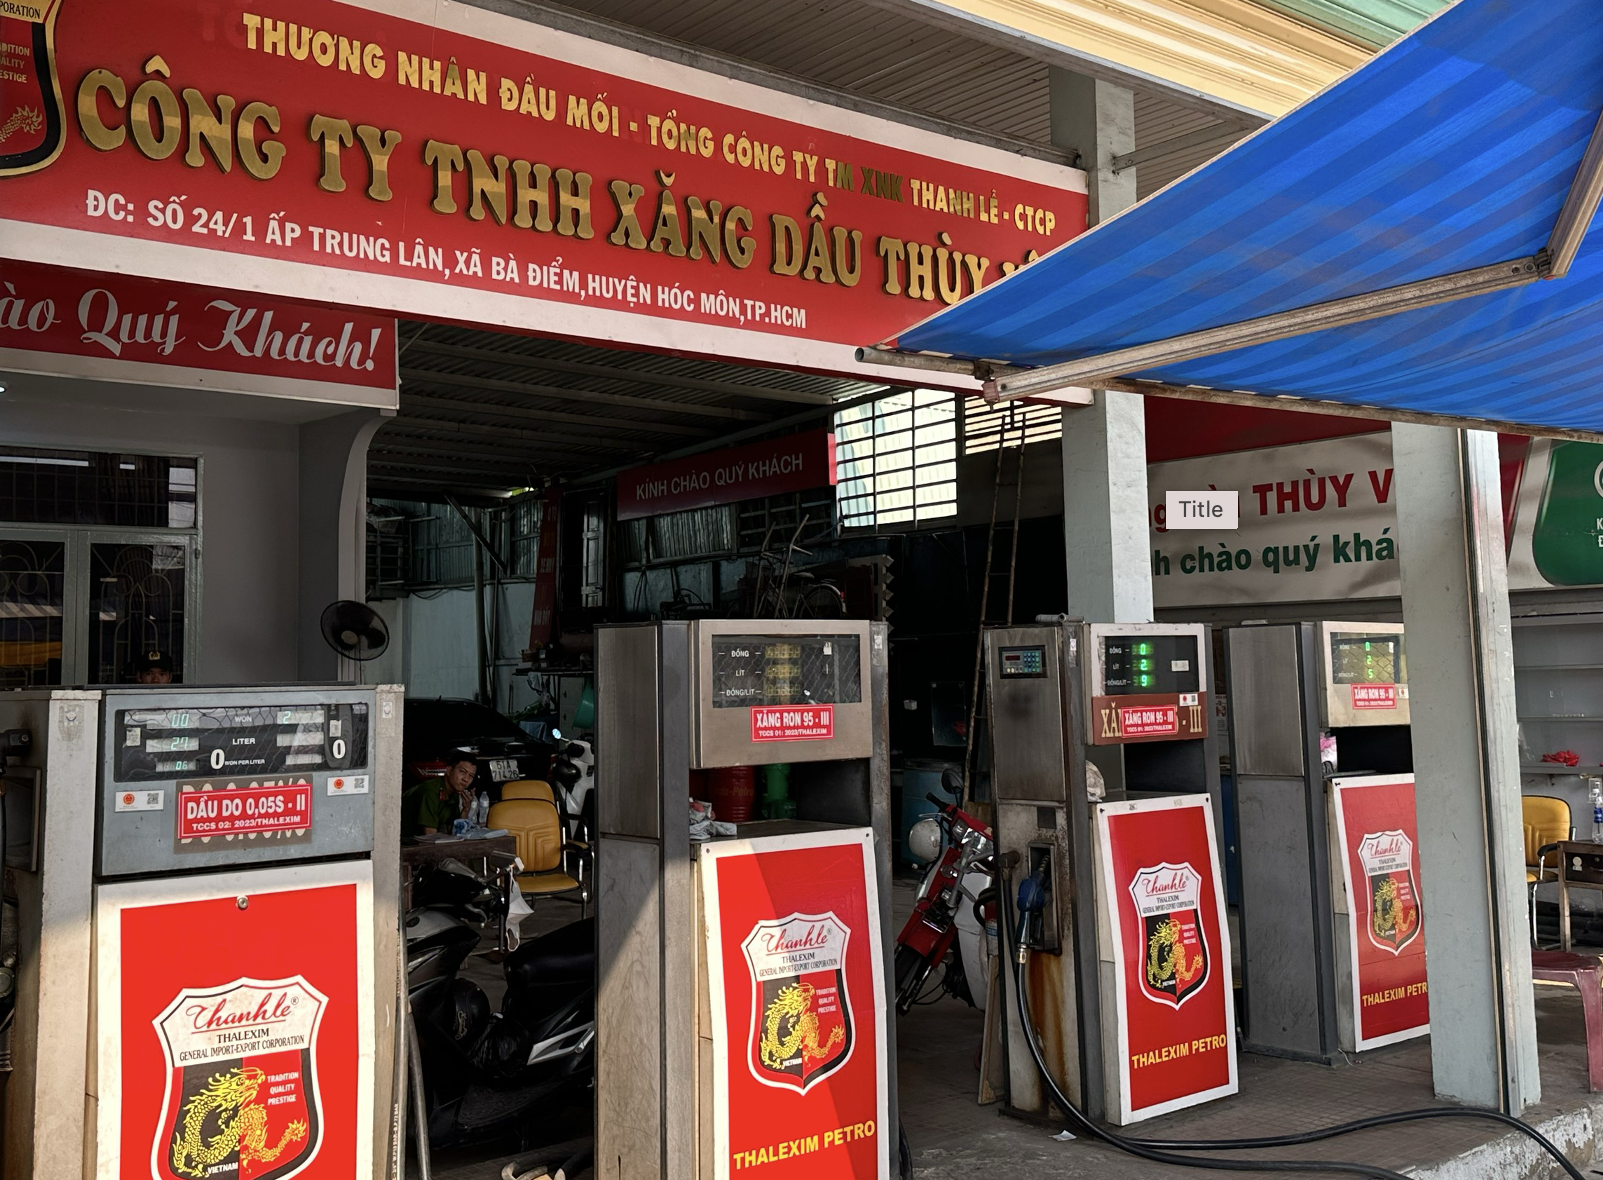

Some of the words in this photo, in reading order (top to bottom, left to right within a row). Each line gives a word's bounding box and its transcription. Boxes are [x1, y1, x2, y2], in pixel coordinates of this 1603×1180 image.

[0, 42, 30, 57] DITION
[242, 12, 386, 80] THƯƠNG
[398, 50, 487, 105] NHÂN
[499, 72, 557, 121] ĐẦU
[566, 92, 619, 137] MỐI
[629, 121, 639, 132] -
[646, 109, 714, 158] TỔNG
[722, 131, 786, 175] CÔNG
[792, 150, 818, 182] TY
[827, 160, 854, 192] TM
[861, 166, 904, 203] XNK
[910, 179, 975, 219] THANH
[1014, 203, 1056, 236] CTCP
[78, 55, 286, 181] CÔNG
[310, 114, 402, 202] TY
[424, 138, 594, 240] TNHH
[608, 169, 756, 269] XĂNG
[769, 191, 863, 288] DẦU
[878, 231, 990, 305] THÙY
[86, 189, 135, 223] ĐC:
[146, 195, 185, 229] SỐ
[265, 211, 301, 248] ẤP
[309, 226, 390, 264] TRUNG
[491, 252, 520, 283] BÀ
[657, 282, 695, 312] HÓC
[78, 288, 186, 357] Quý
[197, 300, 382, 372] Khách!
[636, 478, 668, 501] KÍNH
[670, 470, 710, 495] CHÀO
[714, 461, 745, 487] QUÝ
[748, 452, 803, 480] KHÁCH
[1252, 468, 1354, 516] THÙY
[1180, 543, 1252, 574] chào
[1262, 535, 1321, 574] quý
[756, 710, 781, 728] XĂNG
[783, 711, 802, 727] RON
[803, 711, 814, 726] 95
[820, 710, 830, 726] III
[1124, 710, 1141, 725] XĂNG
[1142, 711, 1155, 724] RON
[1155, 711, 1163, 723] 95
[232, 737, 256, 745] LITER
[187, 796, 218, 819] DẦU
[222, 797, 242, 817] DO
[246, 795, 284, 818] 0,05S
[296, 793, 306, 811] II
[192, 822, 216, 831] TCCS
[218, 821, 232, 829] 02:
[234, 815, 301, 828] 2023/THALEXIM
[782, 952, 816, 964] THALEXIM
[1362, 986, 1405, 1008] THALEXIM
[216, 1028, 270, 1044] THALEXIM
[179, 1050, 209, 1062] GENERAL
[210, 1041, 261, 1057] IMPORT-EXPORT
[262, 1034, 305, 1049] CORPORATION
[1132, 1042, 1189, 1069] THALEXIM
[1192, 1034, 1227, 1056] PETRO
[267, 1071, 299, 1083] TRADITION
[267, 1094, 297, 1106] PRESTIGE
[269, 1083, 295, 1095] QUALITY
[733, 1135, 819, 1170] THALEXIM
[823, 1120, 876, 1149] PETRO
[207, 1163, 239, 1175] VIETNAM
